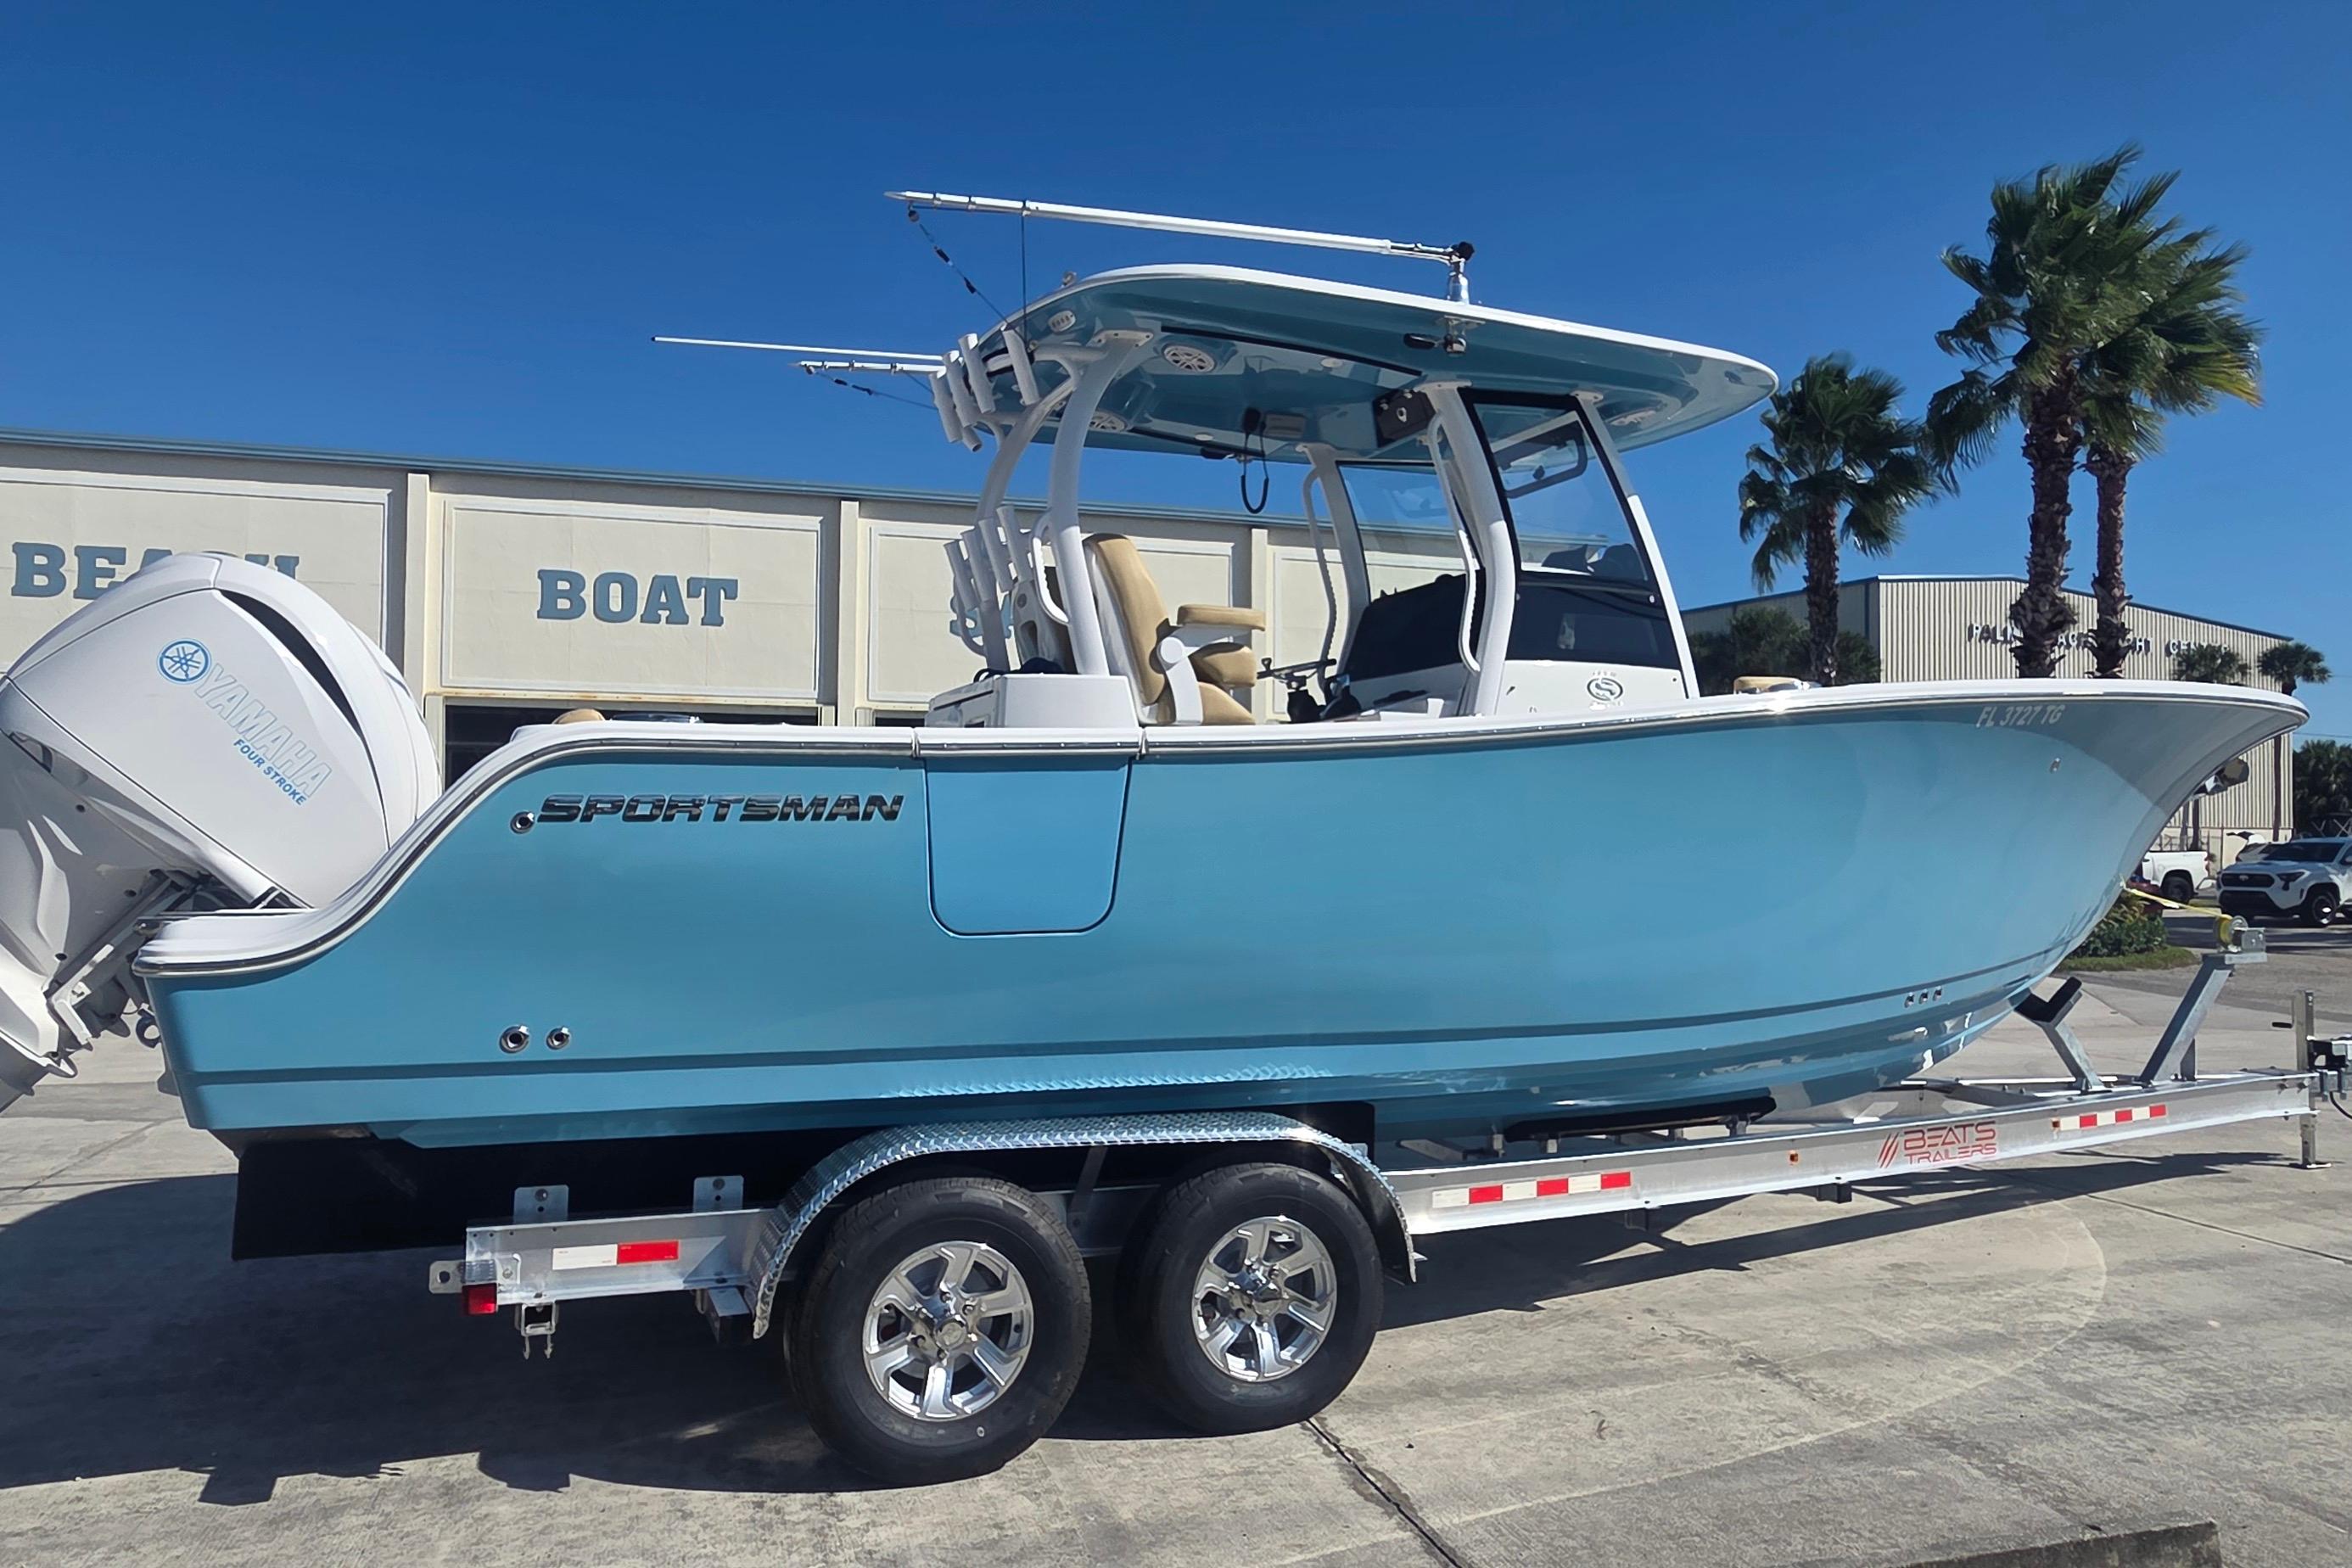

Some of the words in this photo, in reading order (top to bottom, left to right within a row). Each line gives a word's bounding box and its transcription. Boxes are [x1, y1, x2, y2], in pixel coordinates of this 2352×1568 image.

[537, 569, 738, 626] BOAT
[194, 663, 333, 798] YAMAHA
[1976, 706, 1997, 727] FL
[233, 738, 266, 768] FOUR
[263, 766, 307, 805] STROKE
[537, 794, 904, 822] SPORTSMAN
[1904, 1121, 1996, 1151] BEATS
[1904, 1143, 1996, 1165] TRAILERS
